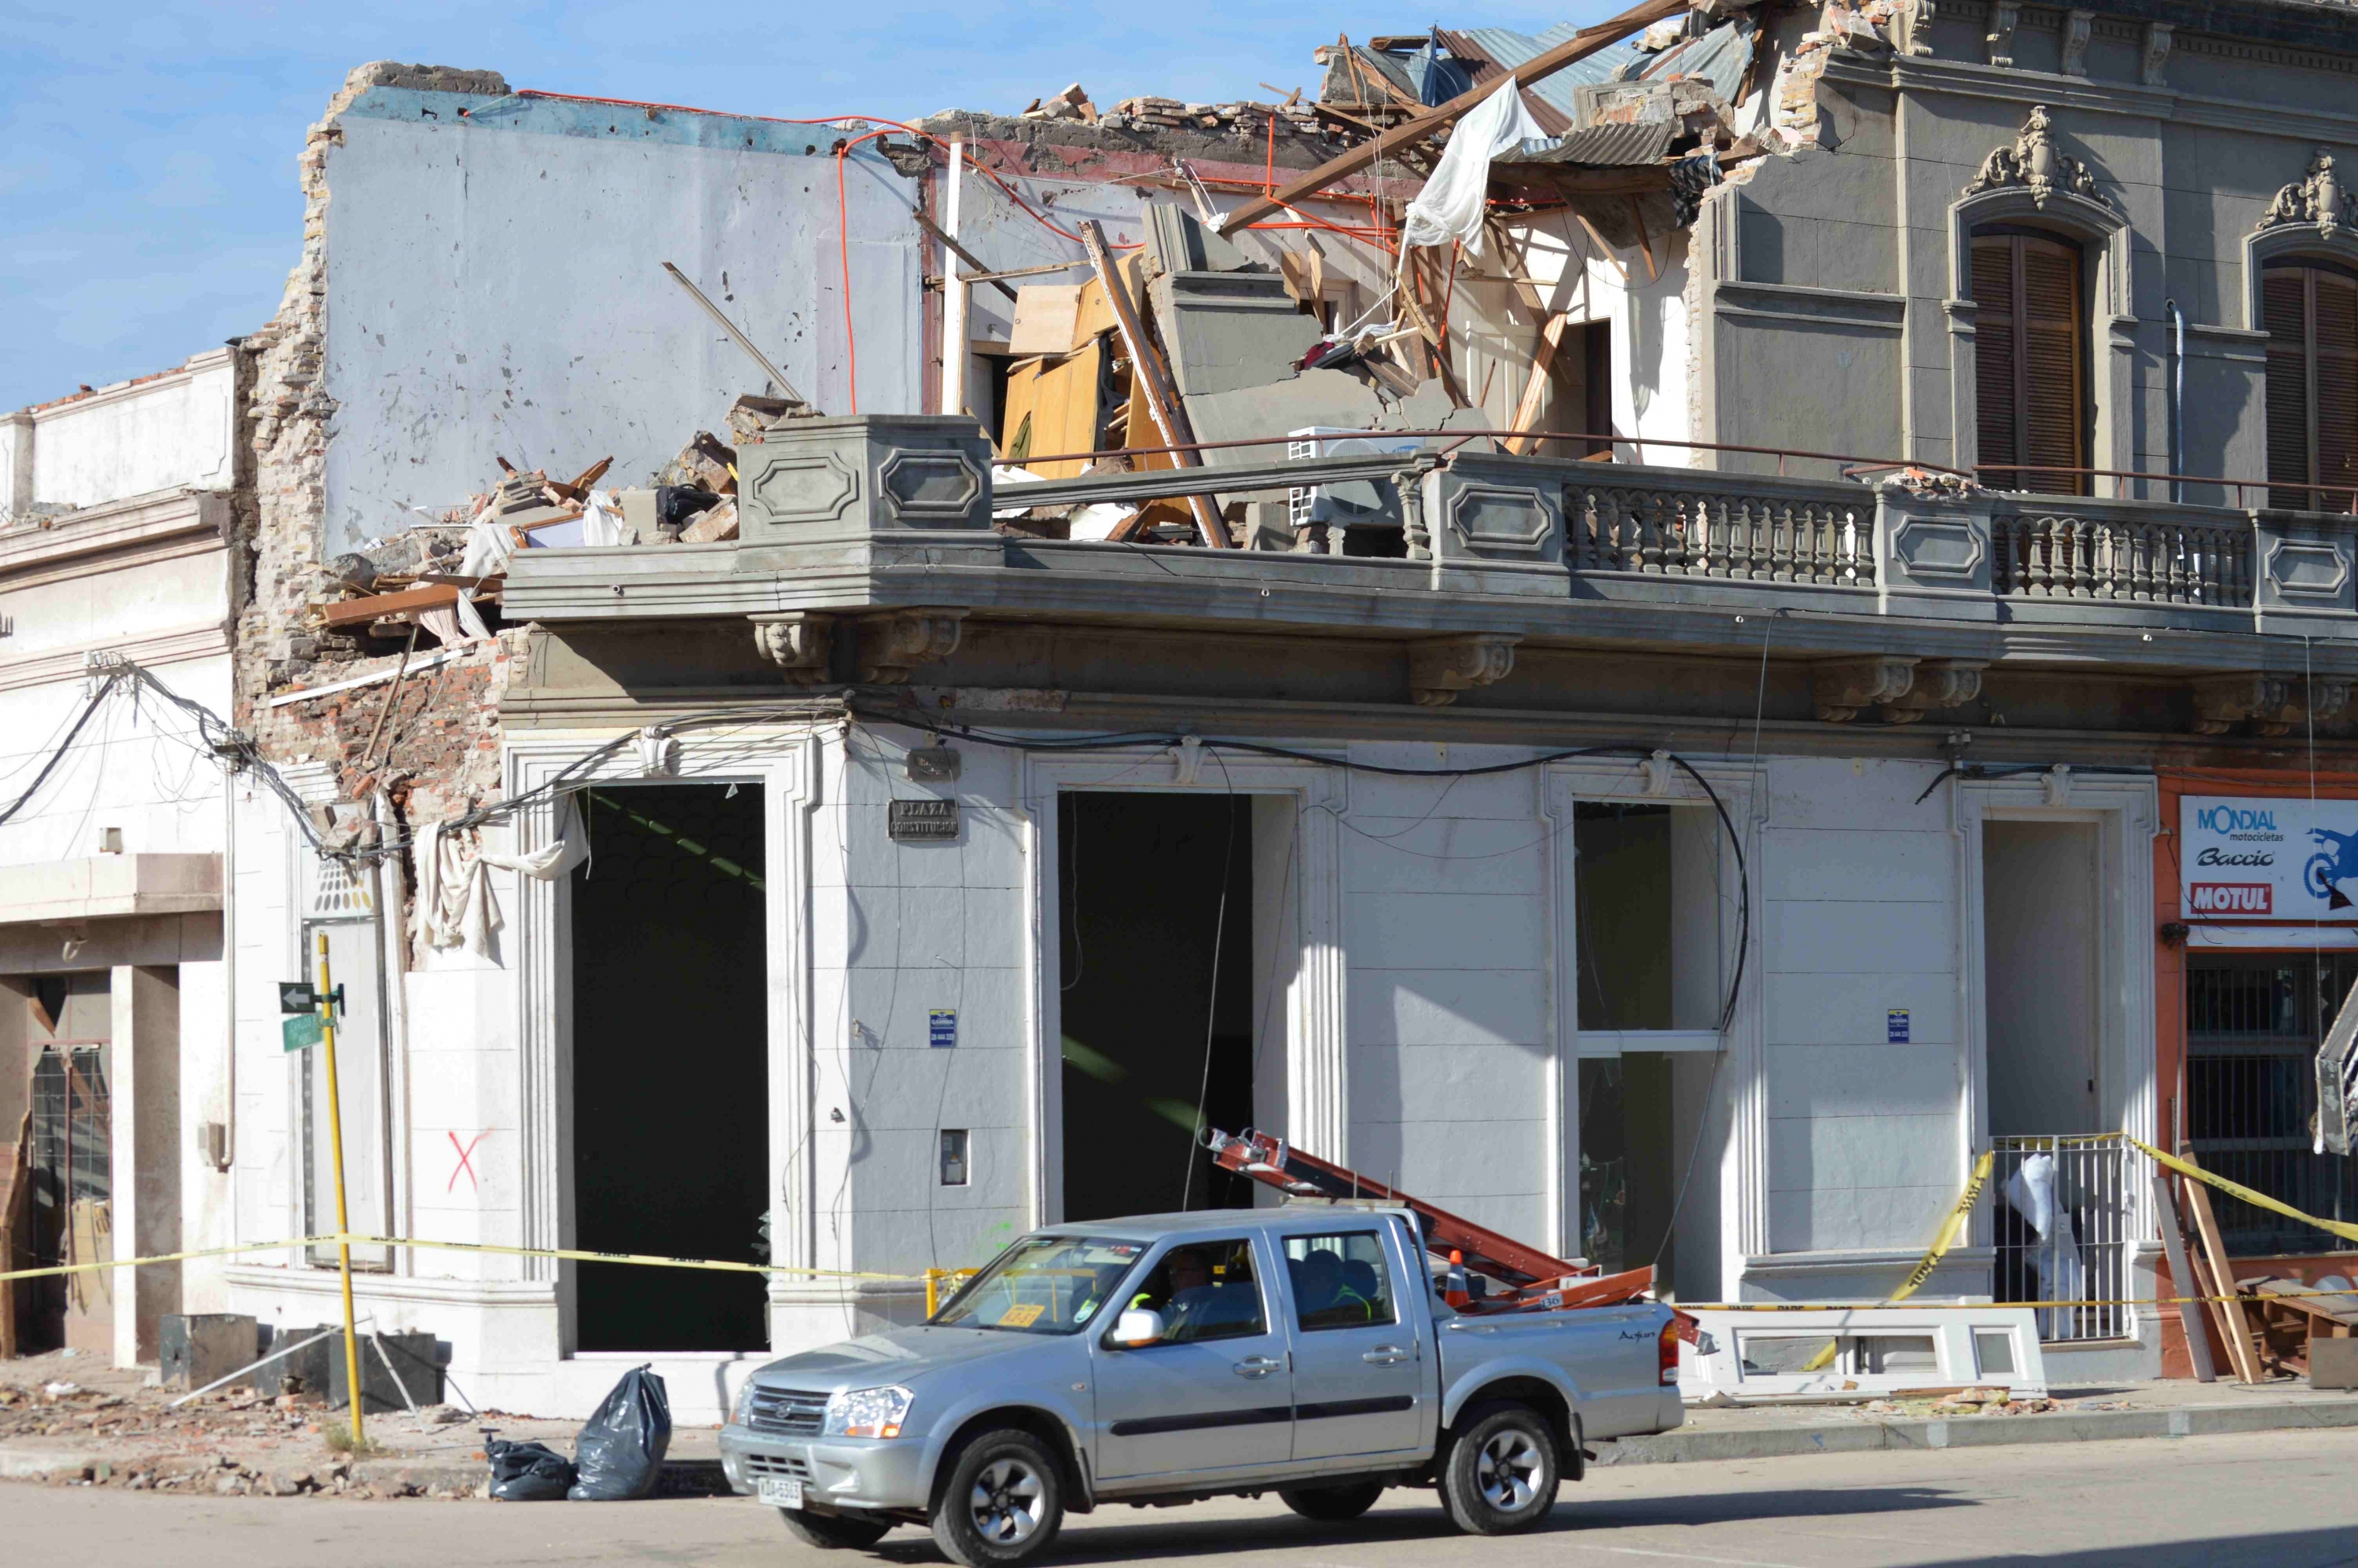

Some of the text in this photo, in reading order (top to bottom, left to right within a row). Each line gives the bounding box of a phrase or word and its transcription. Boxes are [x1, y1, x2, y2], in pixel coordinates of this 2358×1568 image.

[898, 802, 949, 816] PLAZA
[2198, 805, 2276, 835] MONDIAL
[2230, 832, 2284, 842] motocicletas
[2197, 847, 2274, 866] Baccio
[2193, 887, 2268, 910] MOTUL
